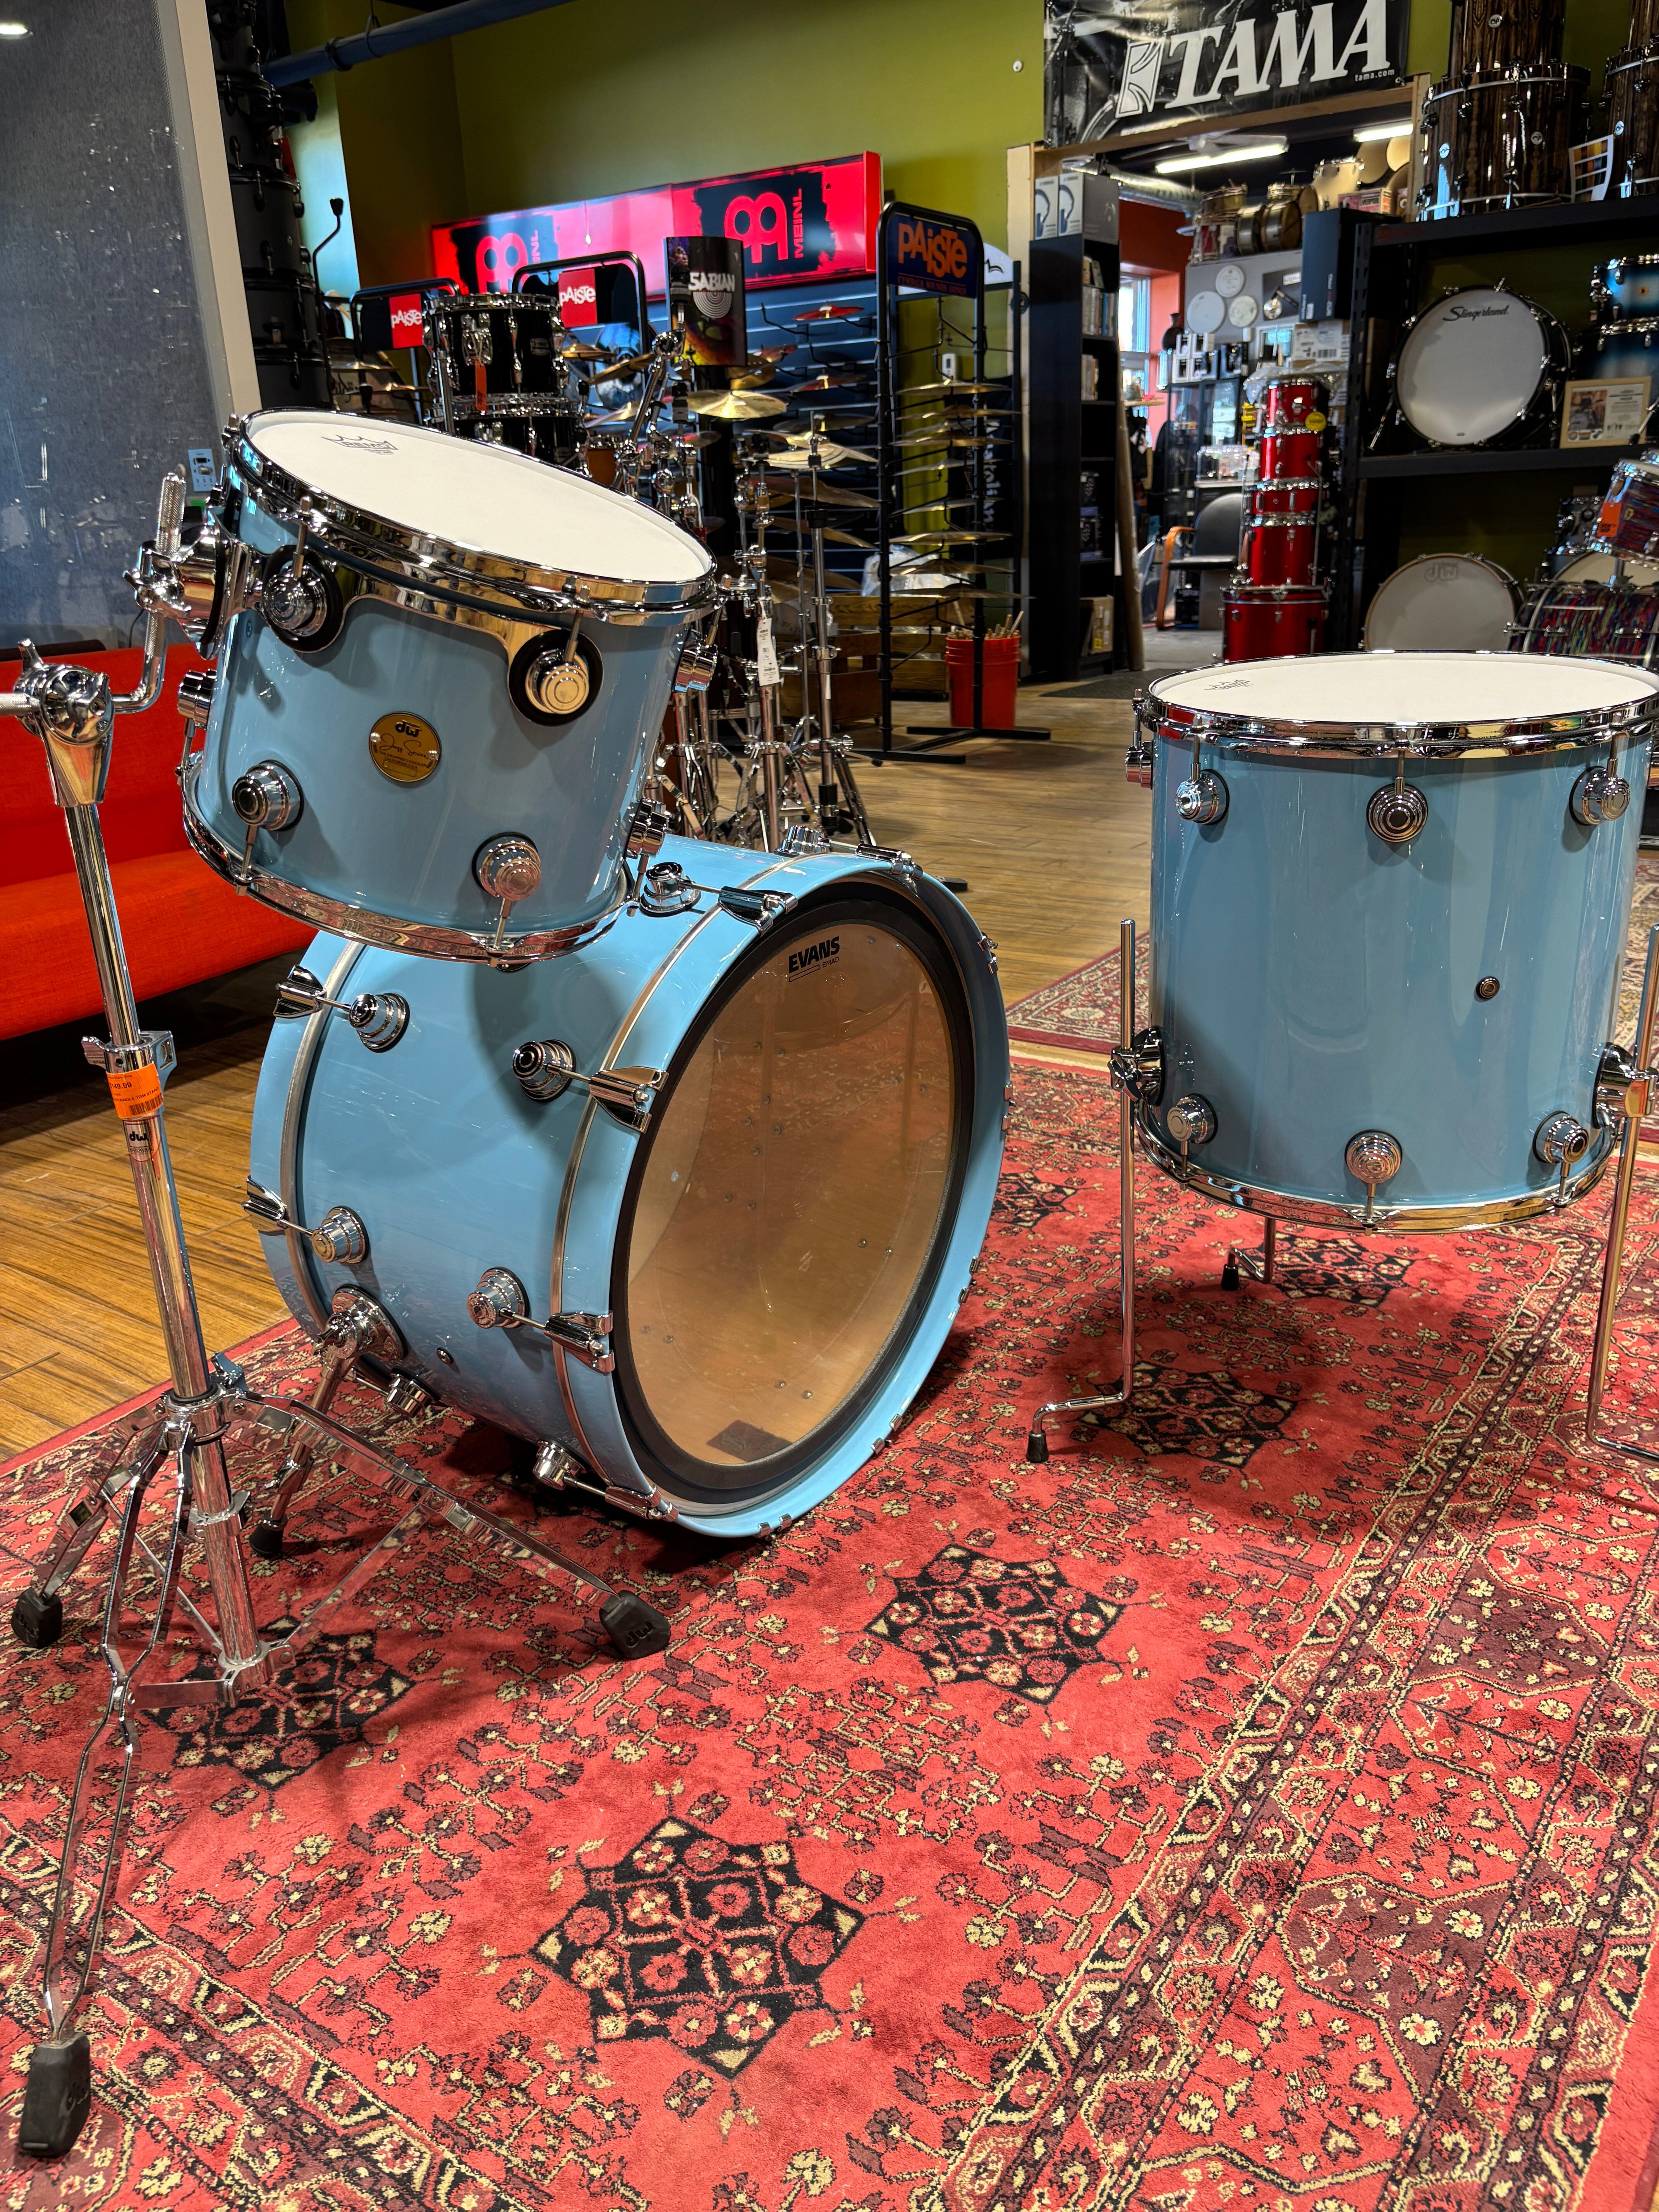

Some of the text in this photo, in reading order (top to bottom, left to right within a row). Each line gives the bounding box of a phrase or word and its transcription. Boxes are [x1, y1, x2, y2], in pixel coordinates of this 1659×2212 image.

[1164, 0, 1391, 109] TAMA
[1355, 69, 1395, 82] tama.com
[792, 188, 804, 258] MEINL
[531, 230, 541, 264] INL
[688, 271, 735, 292] SABIAN
[395, 720, 422, 737] dw
[789, 936, 840, 974] EVANS
[822, 957, 840, 968] EMAD
[129, 1131, 148, 1141] dw
[626, 1621, 656, 1648] dw
